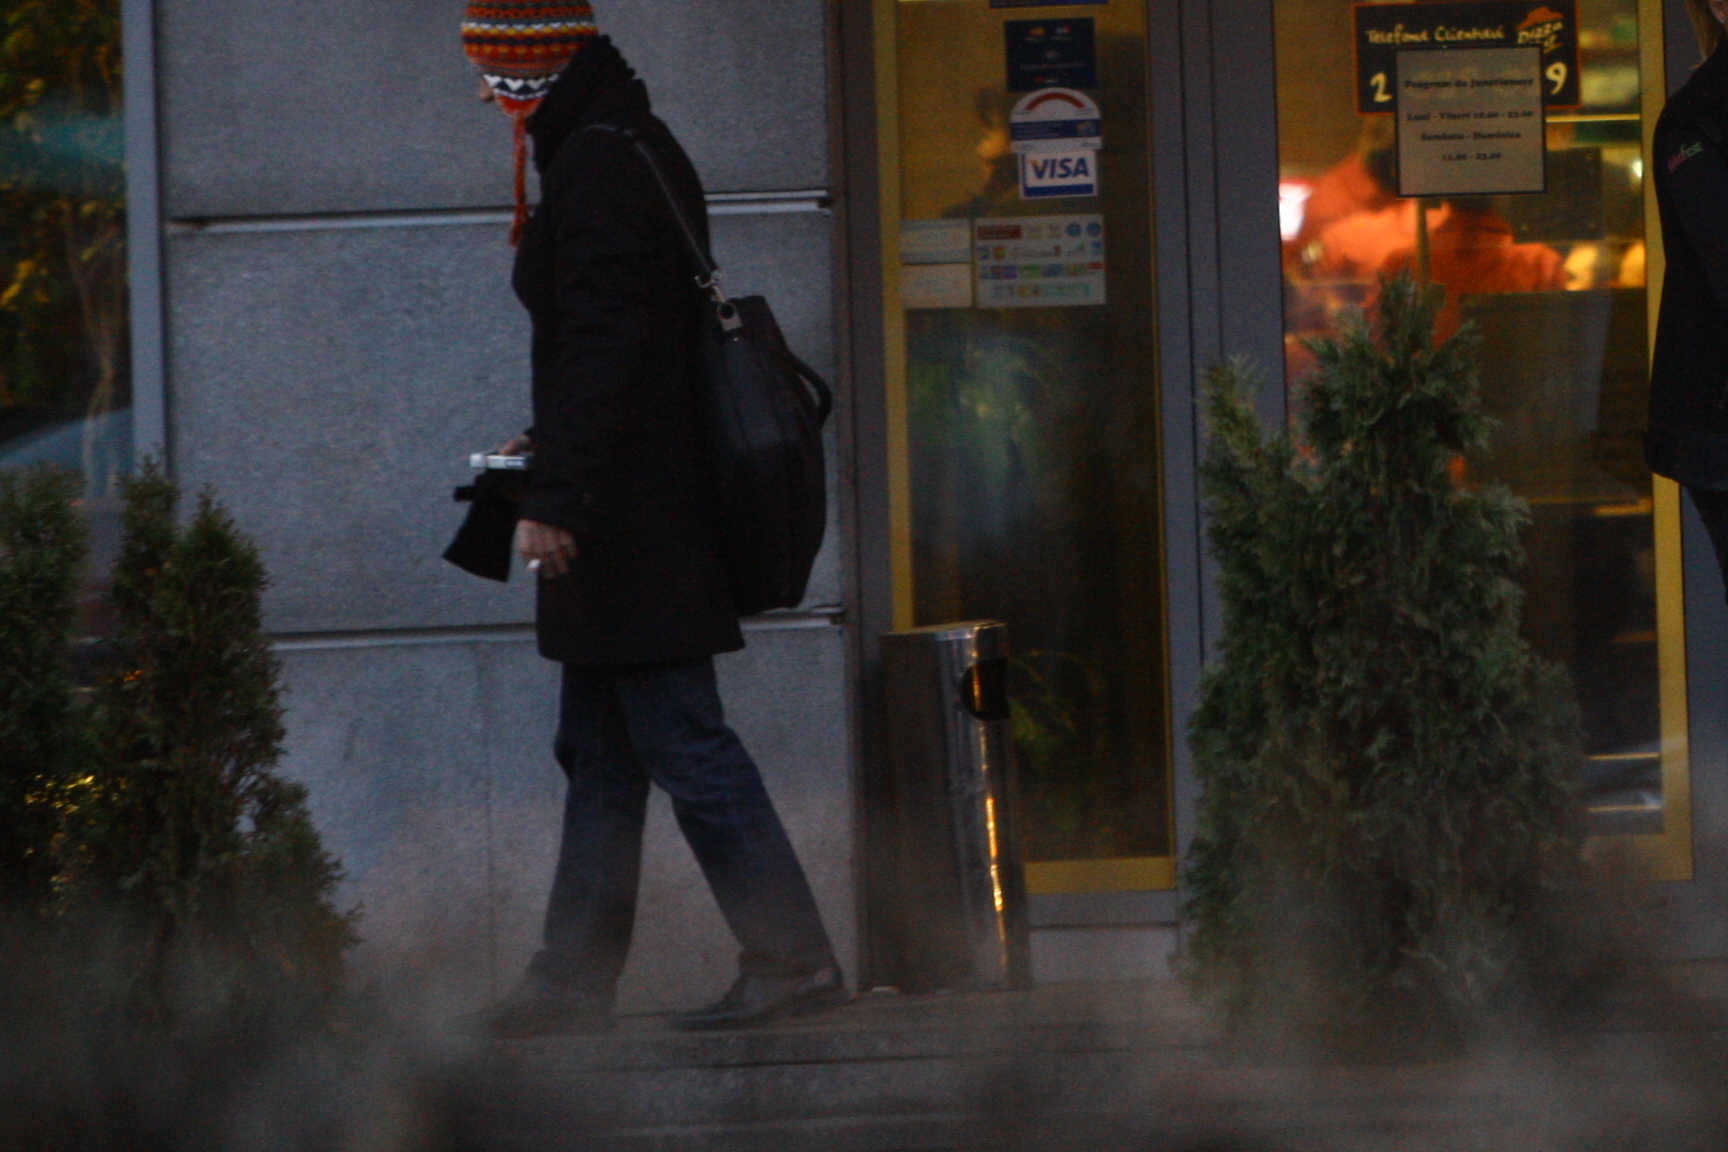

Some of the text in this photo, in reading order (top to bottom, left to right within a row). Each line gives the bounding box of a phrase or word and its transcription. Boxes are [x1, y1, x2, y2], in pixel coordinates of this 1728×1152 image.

[1370, 61, 1568, 103] 2 9
[1031, 157, 1089, 179] VISA
